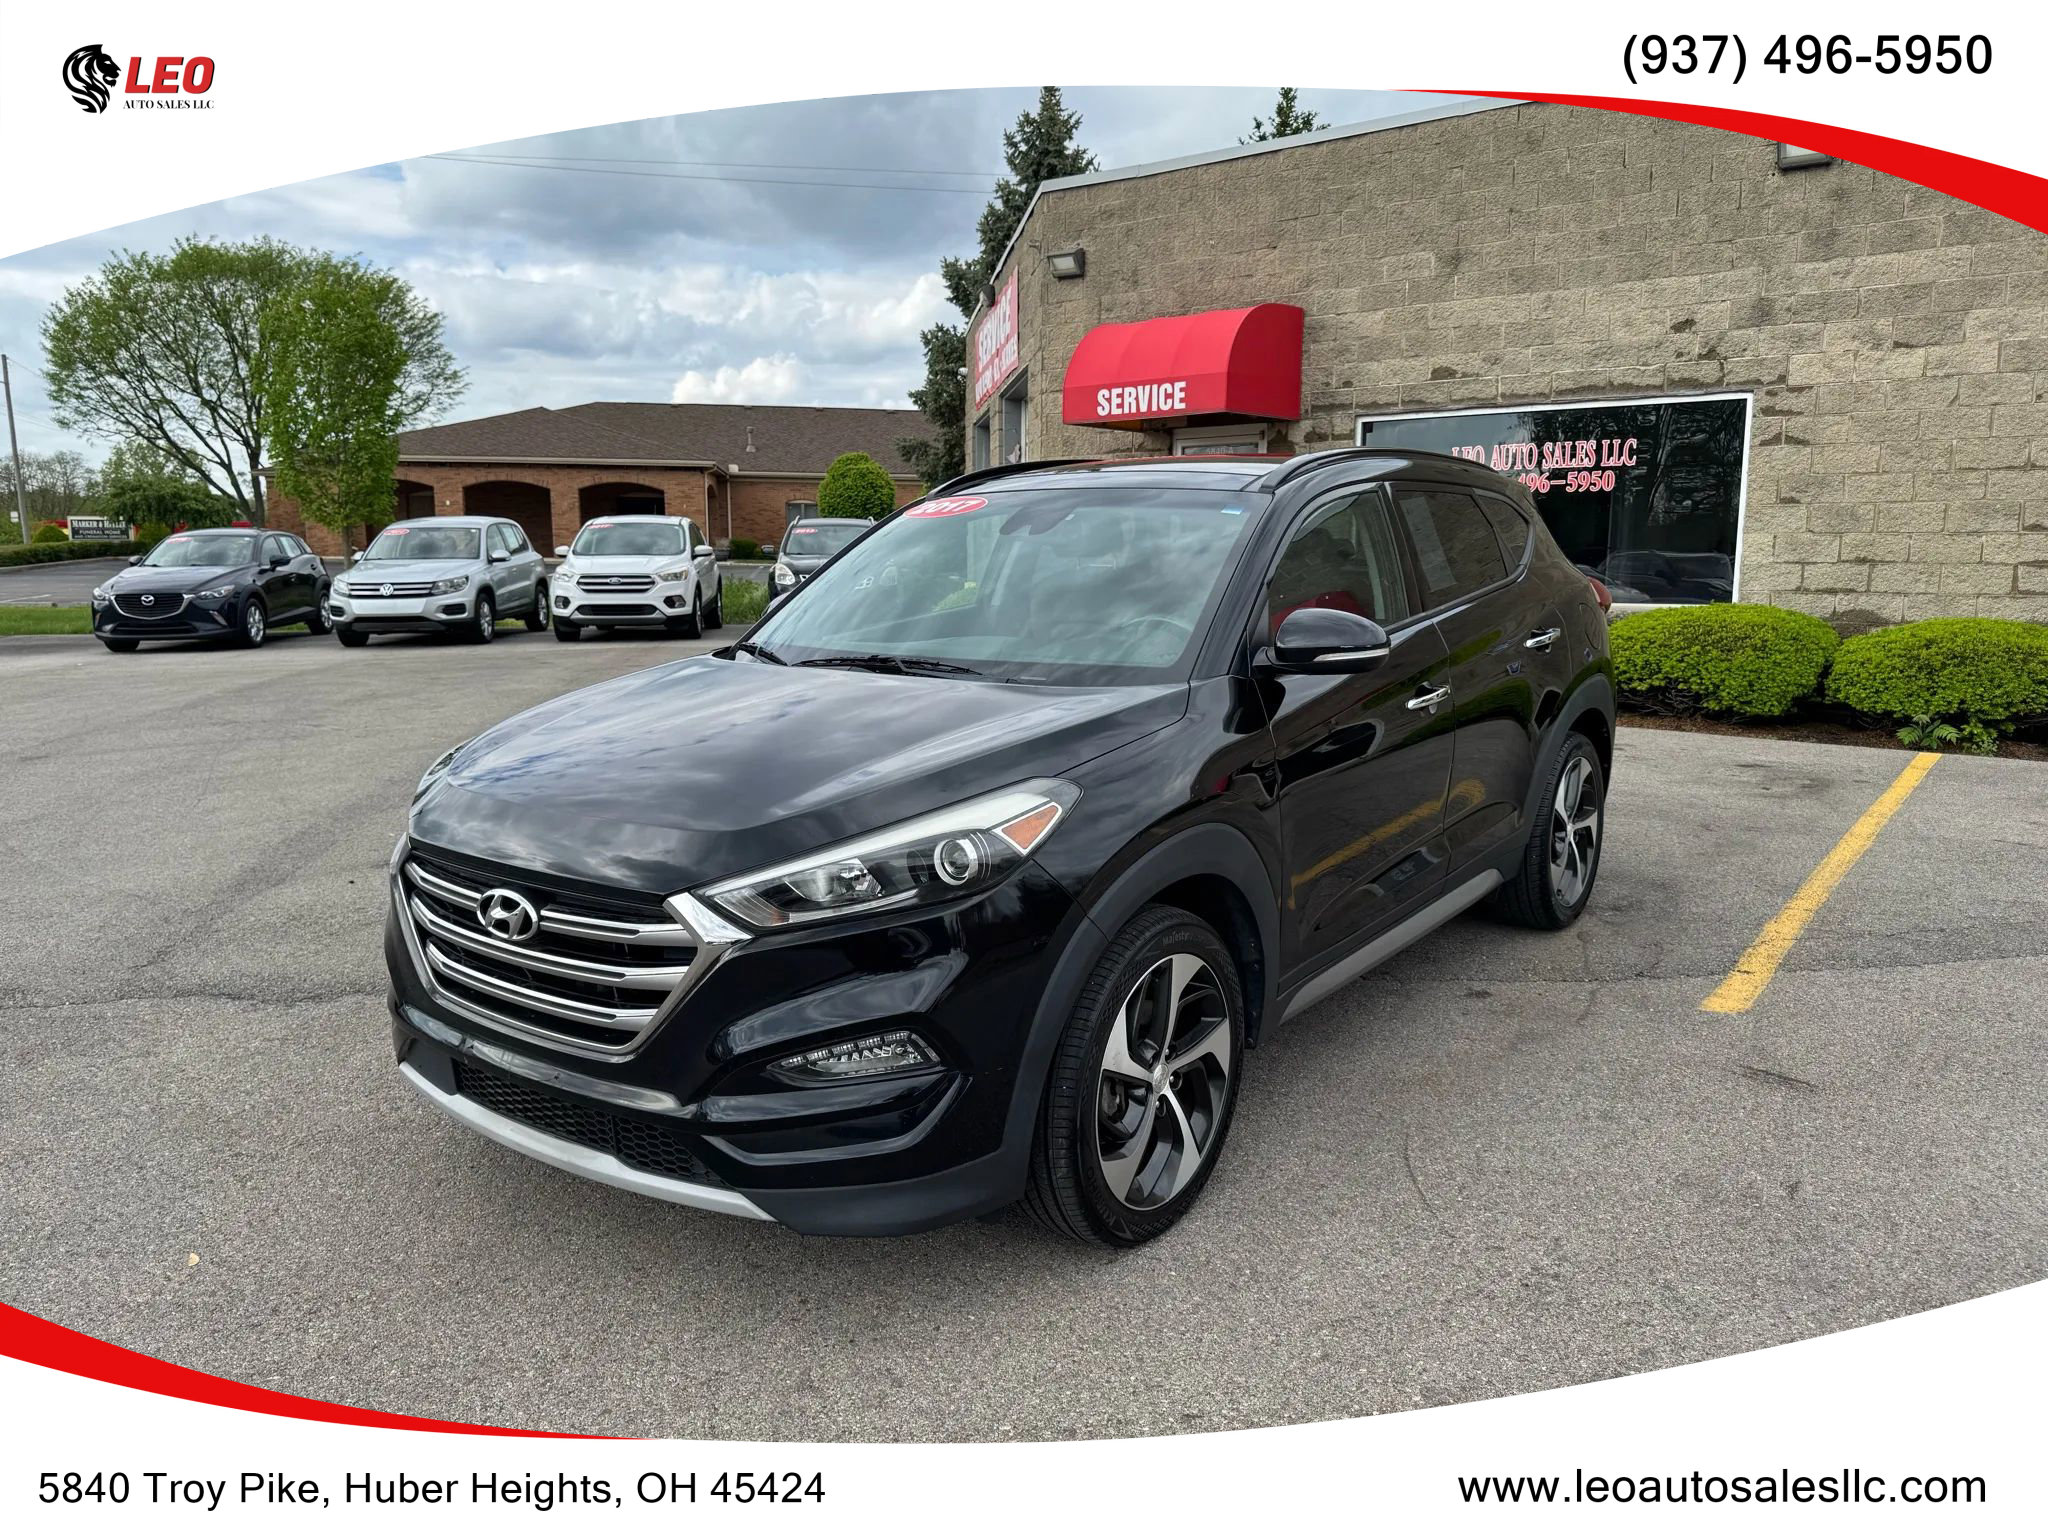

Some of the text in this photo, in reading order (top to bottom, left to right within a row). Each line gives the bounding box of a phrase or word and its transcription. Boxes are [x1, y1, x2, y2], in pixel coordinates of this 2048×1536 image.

[1097, 381, 1187, 417] SERVICE
[1490, 443, 1538, 471] AUTO
[1542, 439, 1597, 470] SALES
[1601, 438, 1637, 467] LLC
[911, 499, 984, 514] 2017
